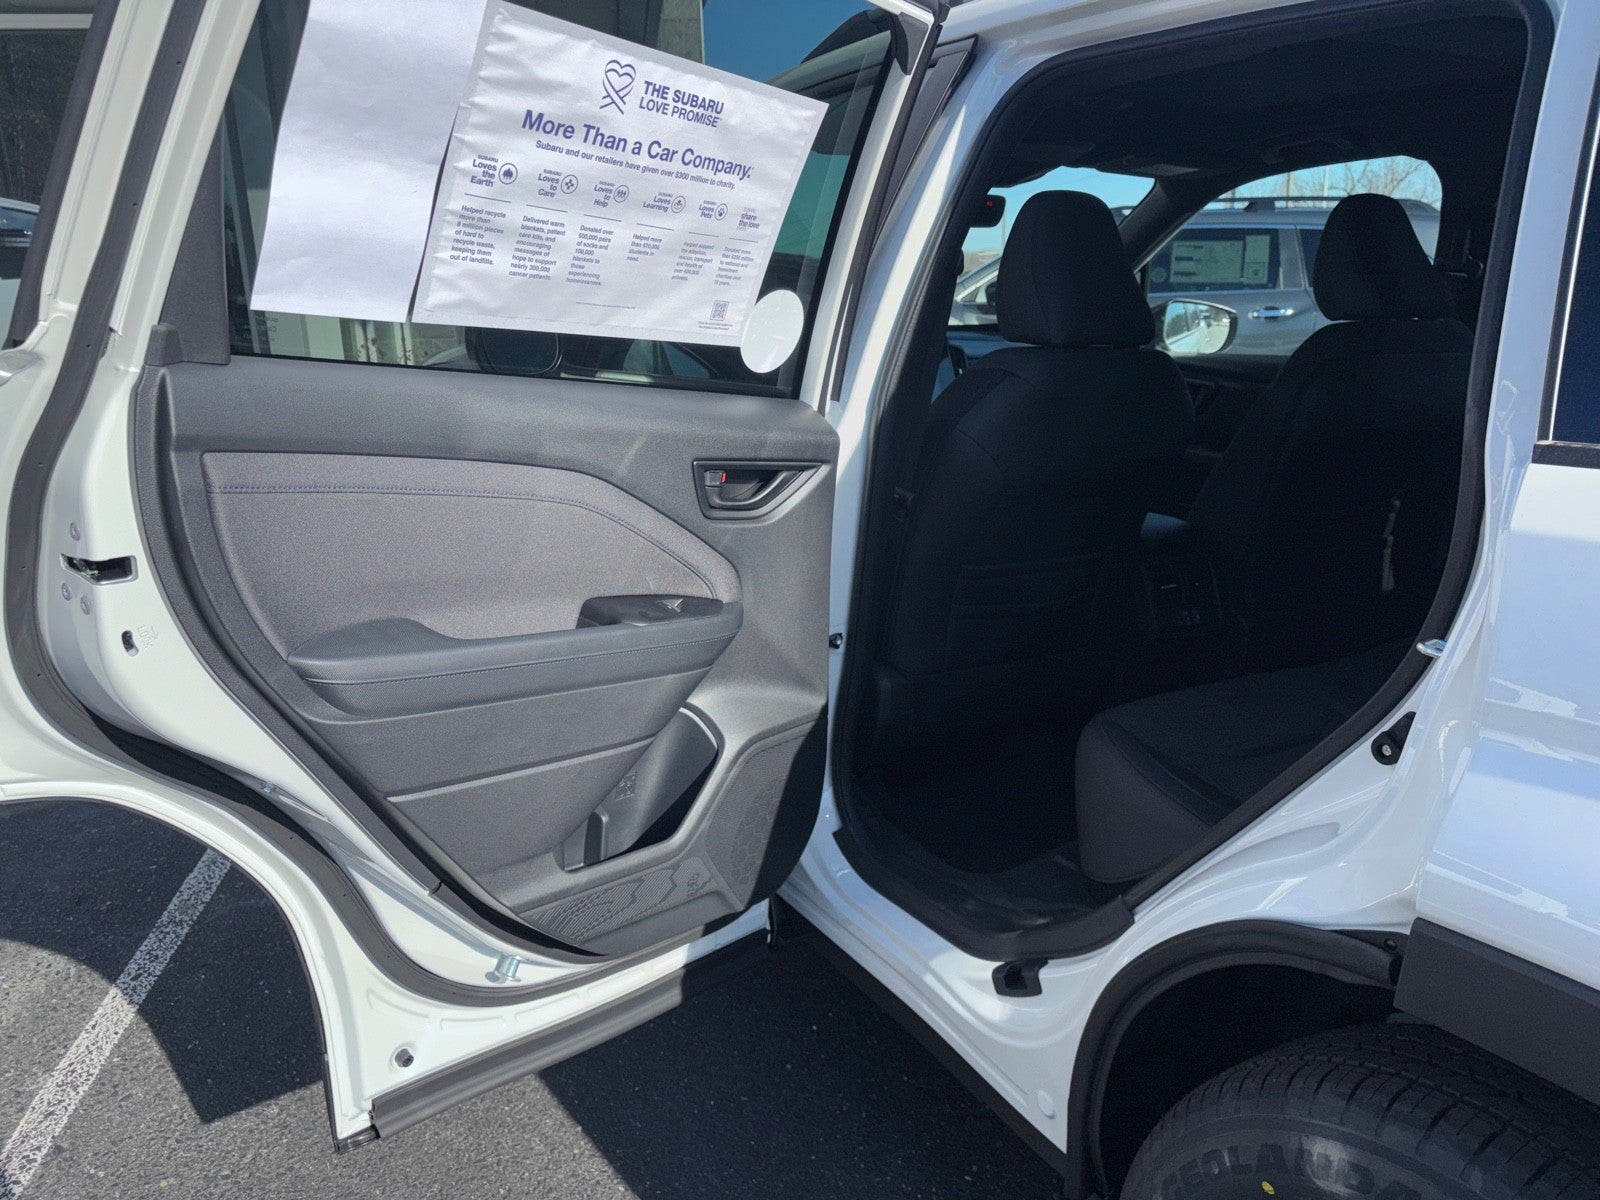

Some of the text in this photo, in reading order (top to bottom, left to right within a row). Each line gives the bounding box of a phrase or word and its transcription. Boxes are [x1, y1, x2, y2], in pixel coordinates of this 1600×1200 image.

[644, 81, 724, 114] THE SUBARU
[639, 97, 719, 127] LOVE PROMISE
[522, 109, 751, 180] More Than a Car Company.
[478, 154, 498, 163] SUBARU
[473, 159, 497, 171] Loves
[536, 140, 563, 153] Subaru
[565, 148, 580, 157] and
[581, 152, 593, 160] our
[595, 155, 623, 167] retailers
[625, 161, 640, 170] have
[641, 165, 659, 174] given
[675, 171, 689, 180] $300
[690, 175, 709, 184] million
[716, 180, 735, 190] charity.
[482, 170, 495, 179] the
[538, 174, 559, 184] Loves
[470, 176, 493, 187] Earth
[538, 189, 555, 197] Care
[594, 185, 613, 194] Loves
[594, 199, 608, 208] Help
[654, 196, 671, 204] Loves
[643, 201, 669, 212] Learning
[699, 204, 714, 212] Loves
[462, 205, 506, 218] Helped recycle
[523, 216, 549, 225] Delivered
[748, 220, 760, 229] love
[521, 224, 545, 233] blankets,
[580, 225, 602, 234] Donated
[476, 241, 495, 249] waste,
[516, 240, 551, 250] encouraging
[451, 245, 475, 255] keeping
[514, 248, 542, 256] messages
[568, 271, 600, 279] experiencing
